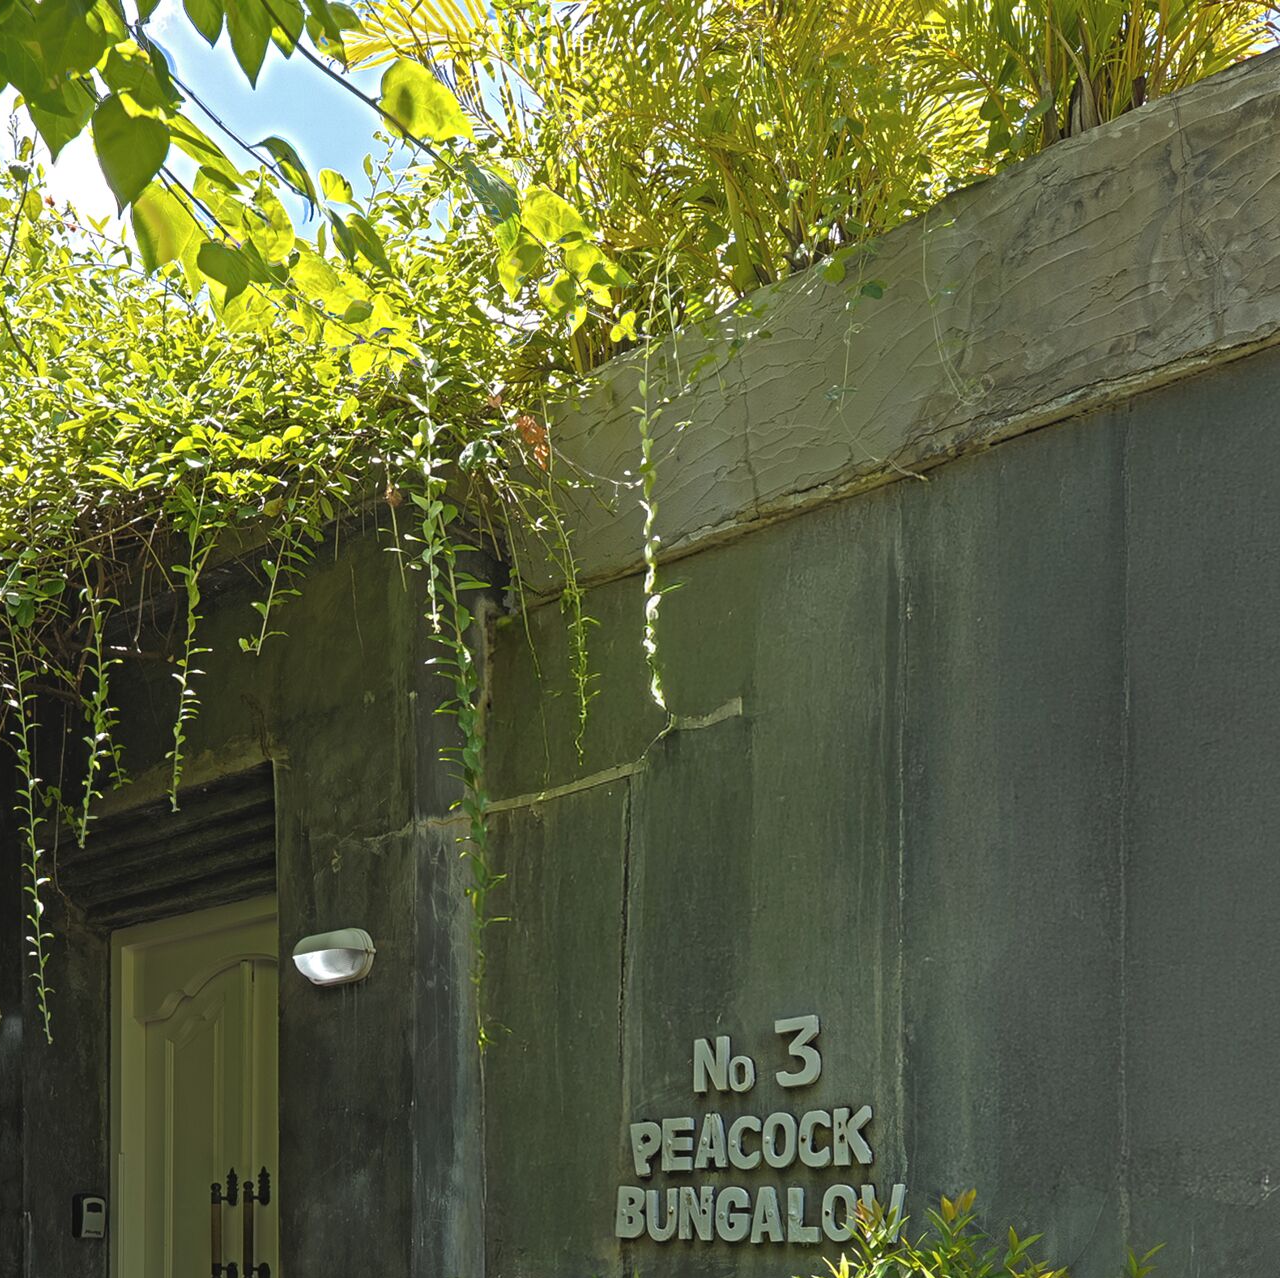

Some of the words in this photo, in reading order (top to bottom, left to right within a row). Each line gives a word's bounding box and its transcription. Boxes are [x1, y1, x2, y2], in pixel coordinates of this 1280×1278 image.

[693, 1035, 756, 1093] No
[774, 1014, 822, 1088] 3
[629, 1104, 874, 1177] PEACOCK
